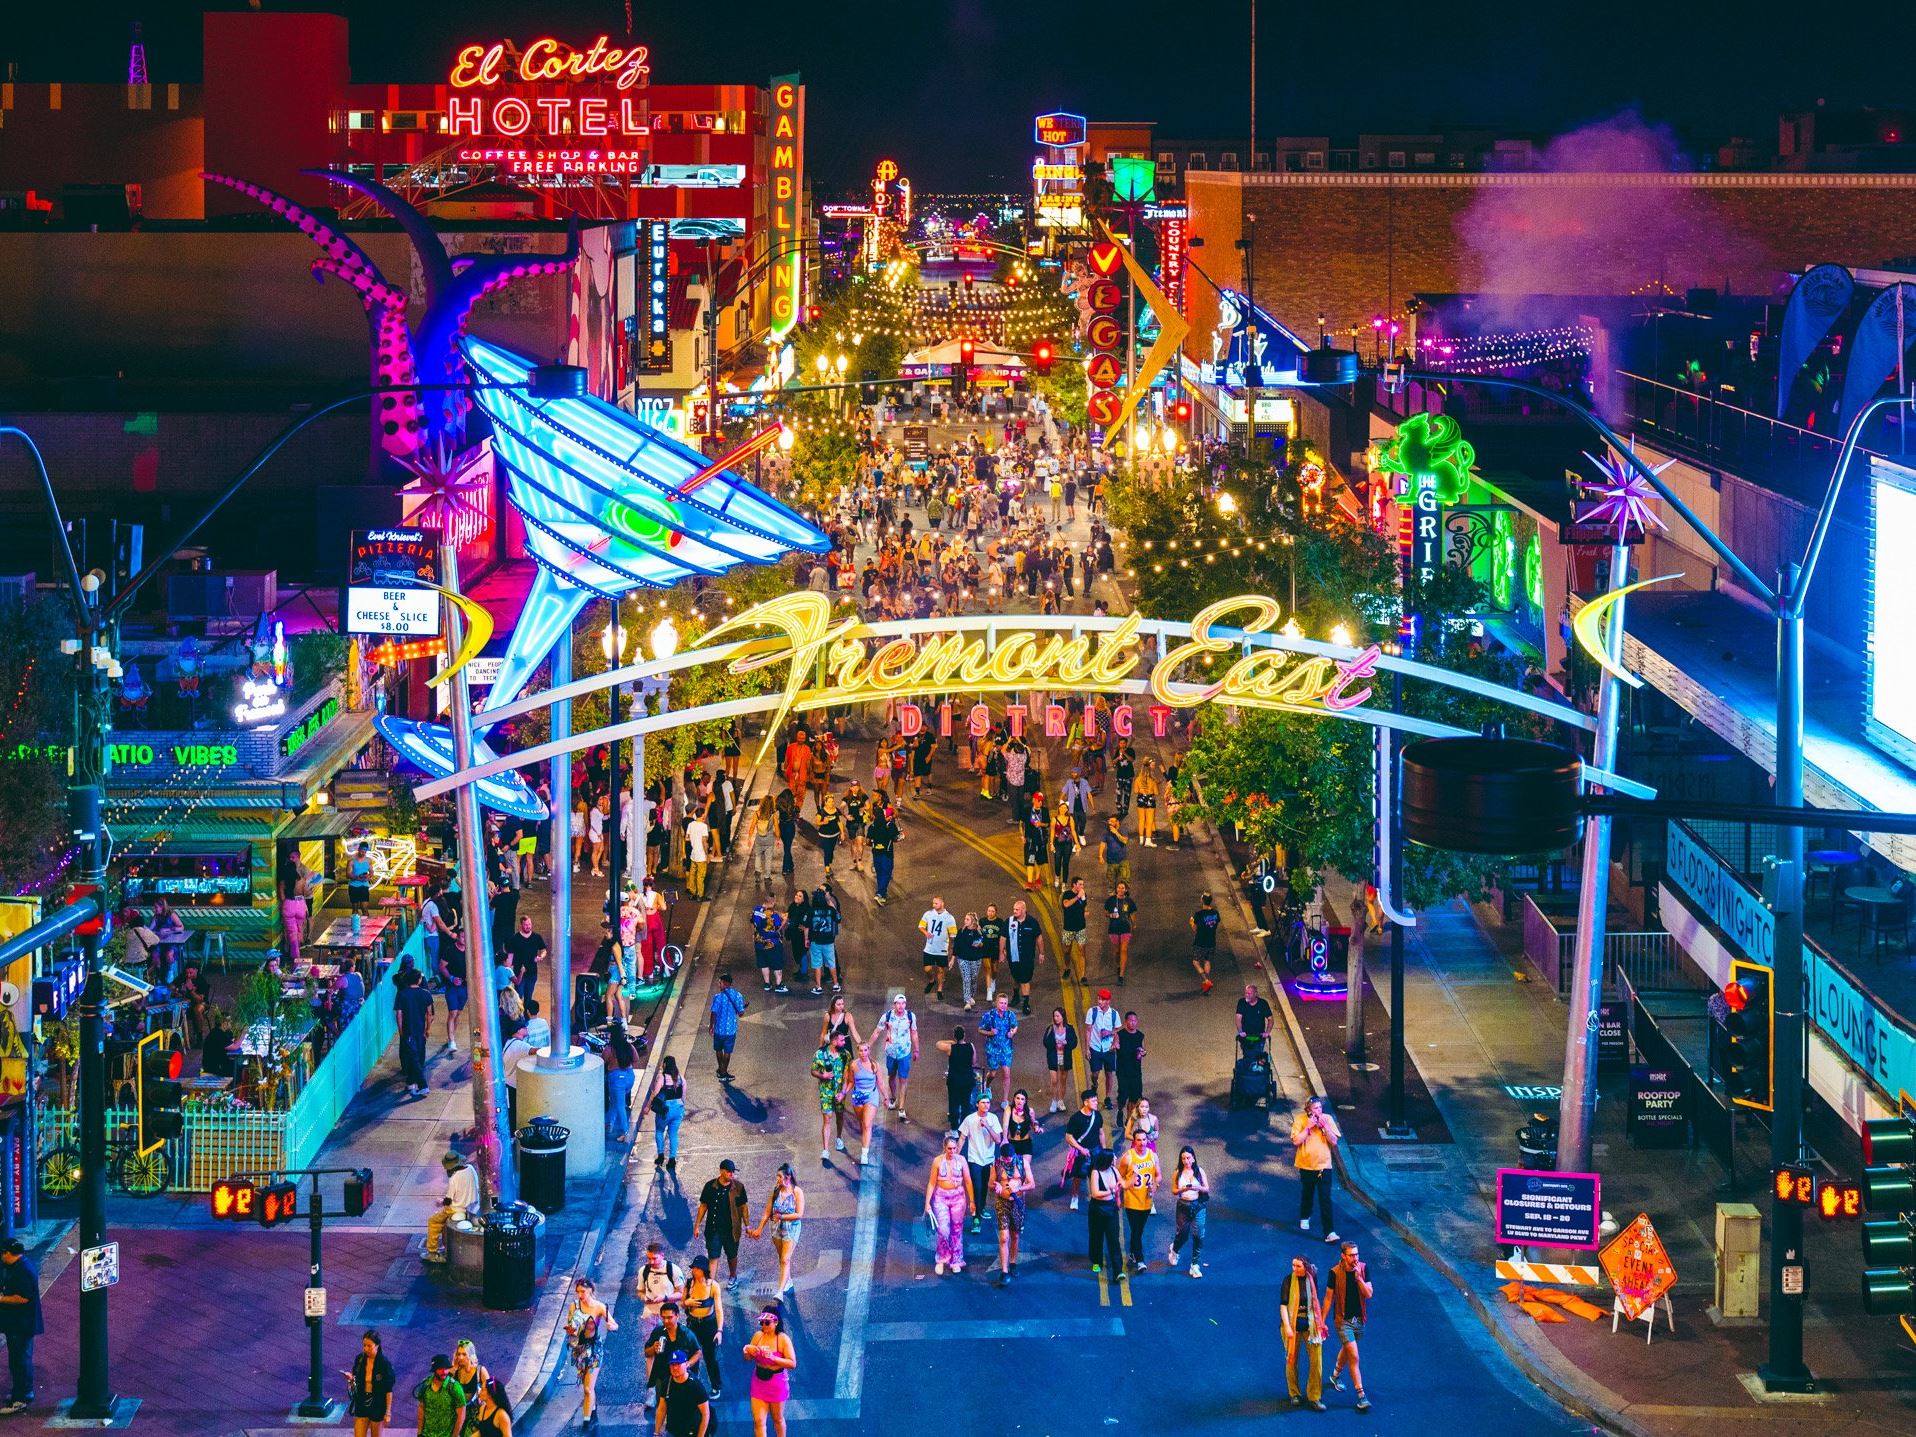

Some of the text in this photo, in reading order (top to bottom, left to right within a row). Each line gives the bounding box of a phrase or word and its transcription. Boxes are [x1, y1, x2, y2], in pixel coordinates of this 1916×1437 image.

[450, 35, 651, 91] El Cortez
[449, 97, 650, 136] HOTEL
[460, 151, 640, 161] COFFEE SHOP & BAR
[513, 161, 638, 173] FREE PARKING
[774, 84, 794, 320] GAMBLING
[1039, 195, 1081, 203] CASINO
[1143, 203, 1187, 219] Fremont
[1167, 220, 1181, 277] COUNTRY
[652, 224, 665, 333] Eureka
[1091, 245, 1121, 424] VEGAS
[993, 368, 1009, 377] VIP
[368, 531, 424, 543] Evel Knievel's
[358, 542, 435, 561] PIZZERIA
[383, 591, 406, 601] BEER
[392, 602, 399, 611] &
[356, 610, 428, 622] CHEESE SLICE
[381, 622, 410, 632] $8.00
[692, 590, 1381, 765] Fremont East
[900, 703, 1174, 738] DISTRICT
[110, 744, 238, 766] ATIO VIBES
[930, 919, 942, 937] 14
[1670, 832, 1677, 871] 3
[1678, 842, 1716, 904] FLOORS
[1818, 971, 1889, 1080] LOUNGE
[1504, 1085, 1562, 1097] INSP
[1637, 1091, 1681, 1100] ROOFTOP
[1645, 1100, 1674, 1109] PARTY
[1133, 1173, 1151, 1187] 32
[1521, 1193, 1573, 1204] SIGNIFICANT
[1504, 1199, 1546, 1209] CLOSURES
[1554, 1202, 1592, 1211] DETOURS
[1524, 1212, 1542, 1220] SEP.
[1505, 1224, 1532, 1232] STEWART
[1538, 1232, 1569, 1240] MARYLAND
[1623, 1257, 1654, 1275] EVENT
[1622, 1275, 1650, 1290] AHEA
